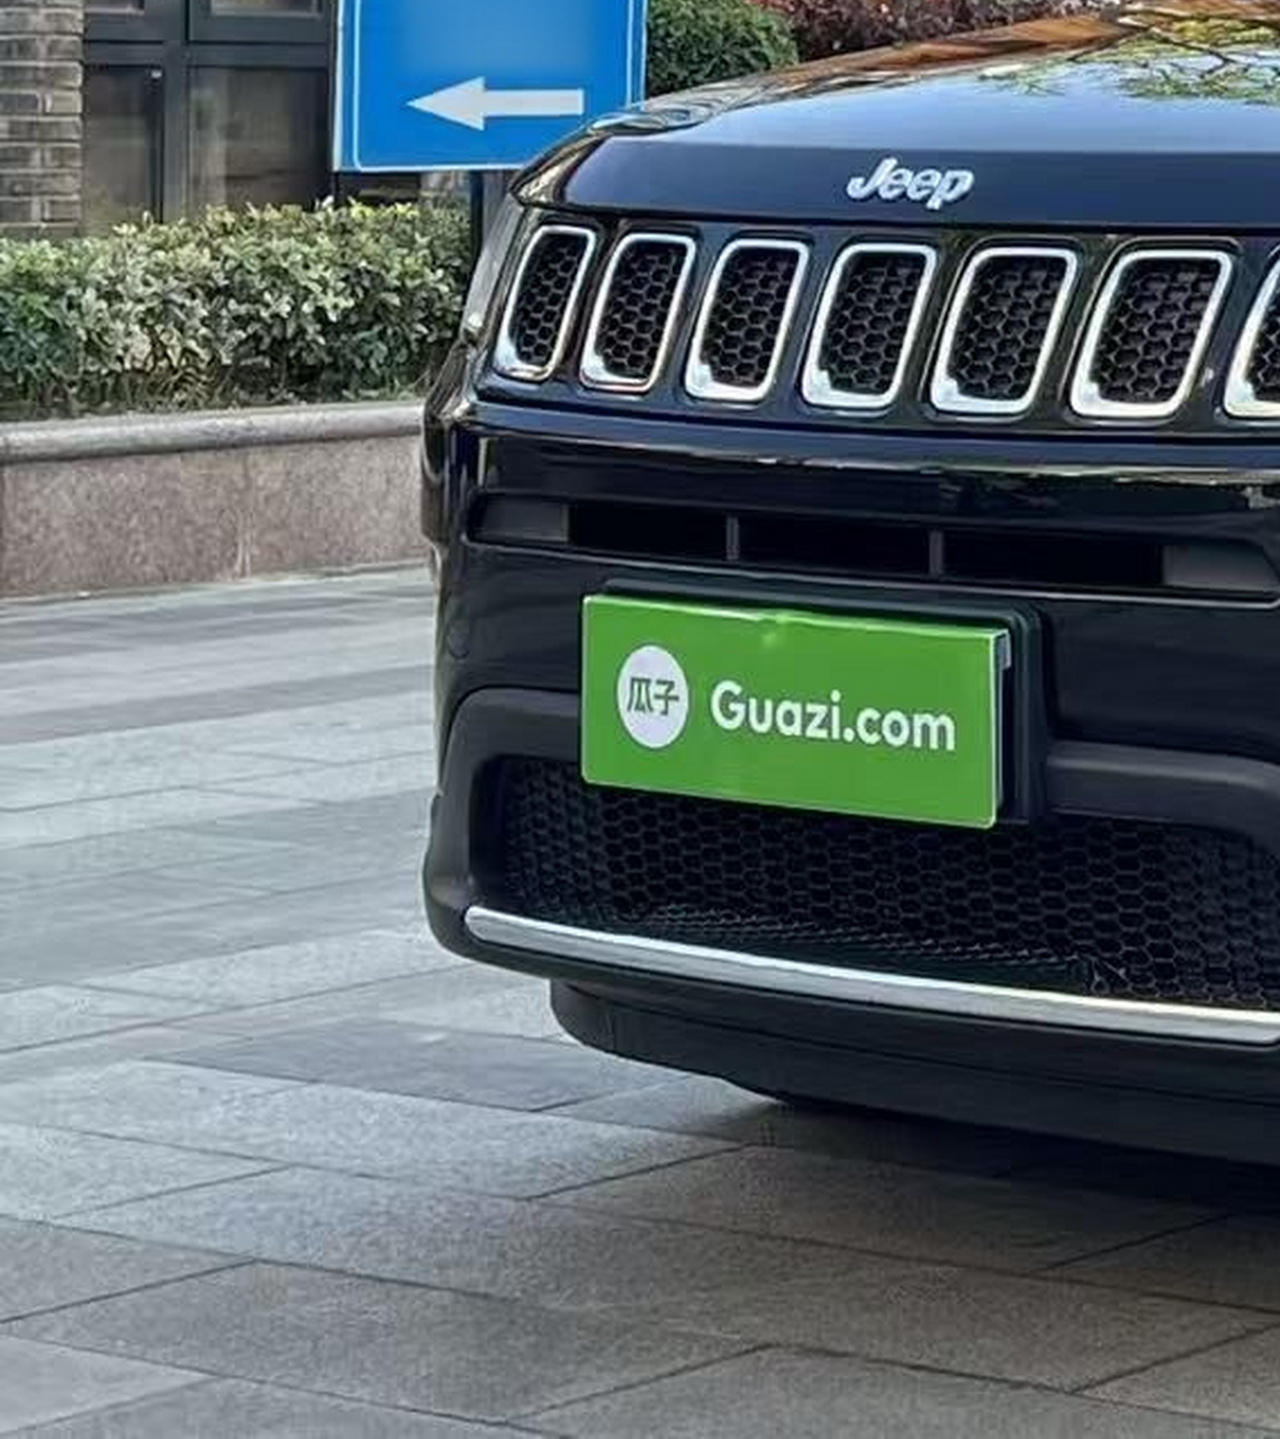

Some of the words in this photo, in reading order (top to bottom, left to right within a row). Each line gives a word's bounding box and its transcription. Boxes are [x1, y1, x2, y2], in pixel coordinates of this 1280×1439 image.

[846, 157, 974, 210] Jeep
[627, 677, 680, 716] 瓜子
[711, 679, 957, 751] Guazi.com
